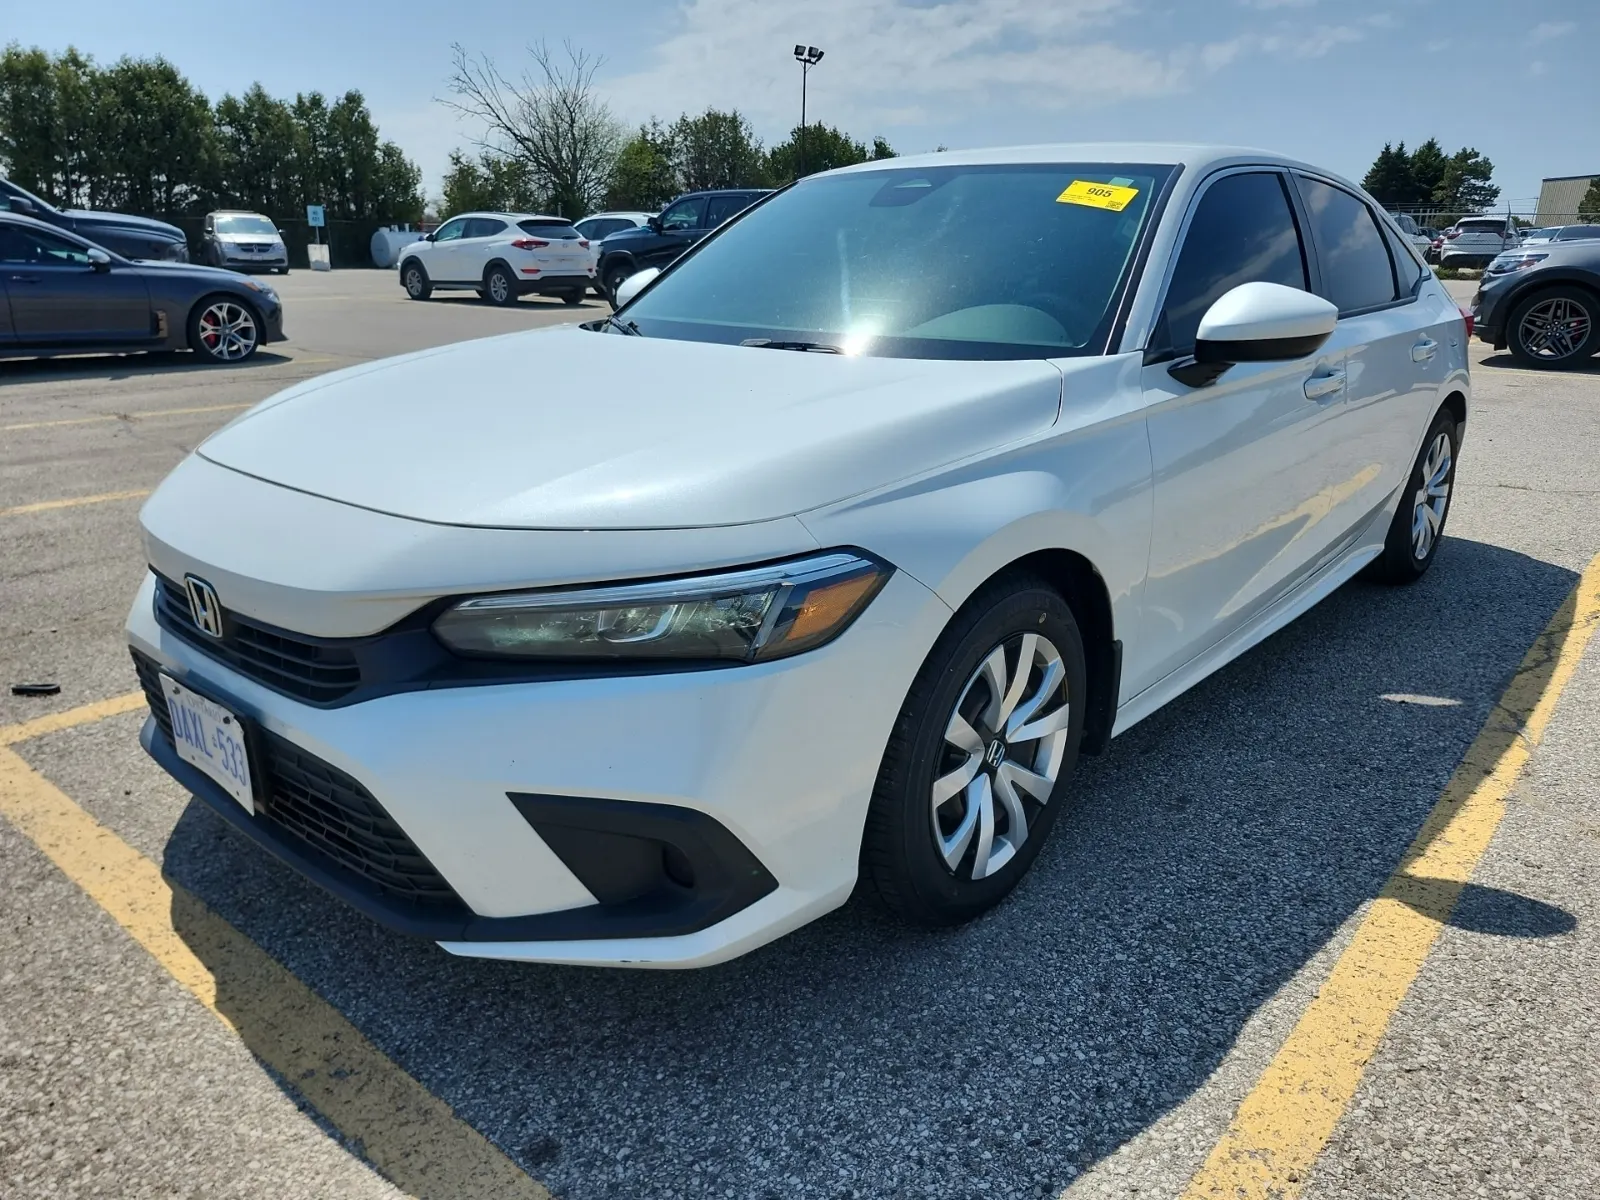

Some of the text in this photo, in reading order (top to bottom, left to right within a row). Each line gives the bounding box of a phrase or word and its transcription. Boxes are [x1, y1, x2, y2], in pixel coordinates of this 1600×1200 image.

[1087, 187, 1113, 198] 905
[169, 698, 213, 758] DAXL
[216, 727, 249, 787] 533
